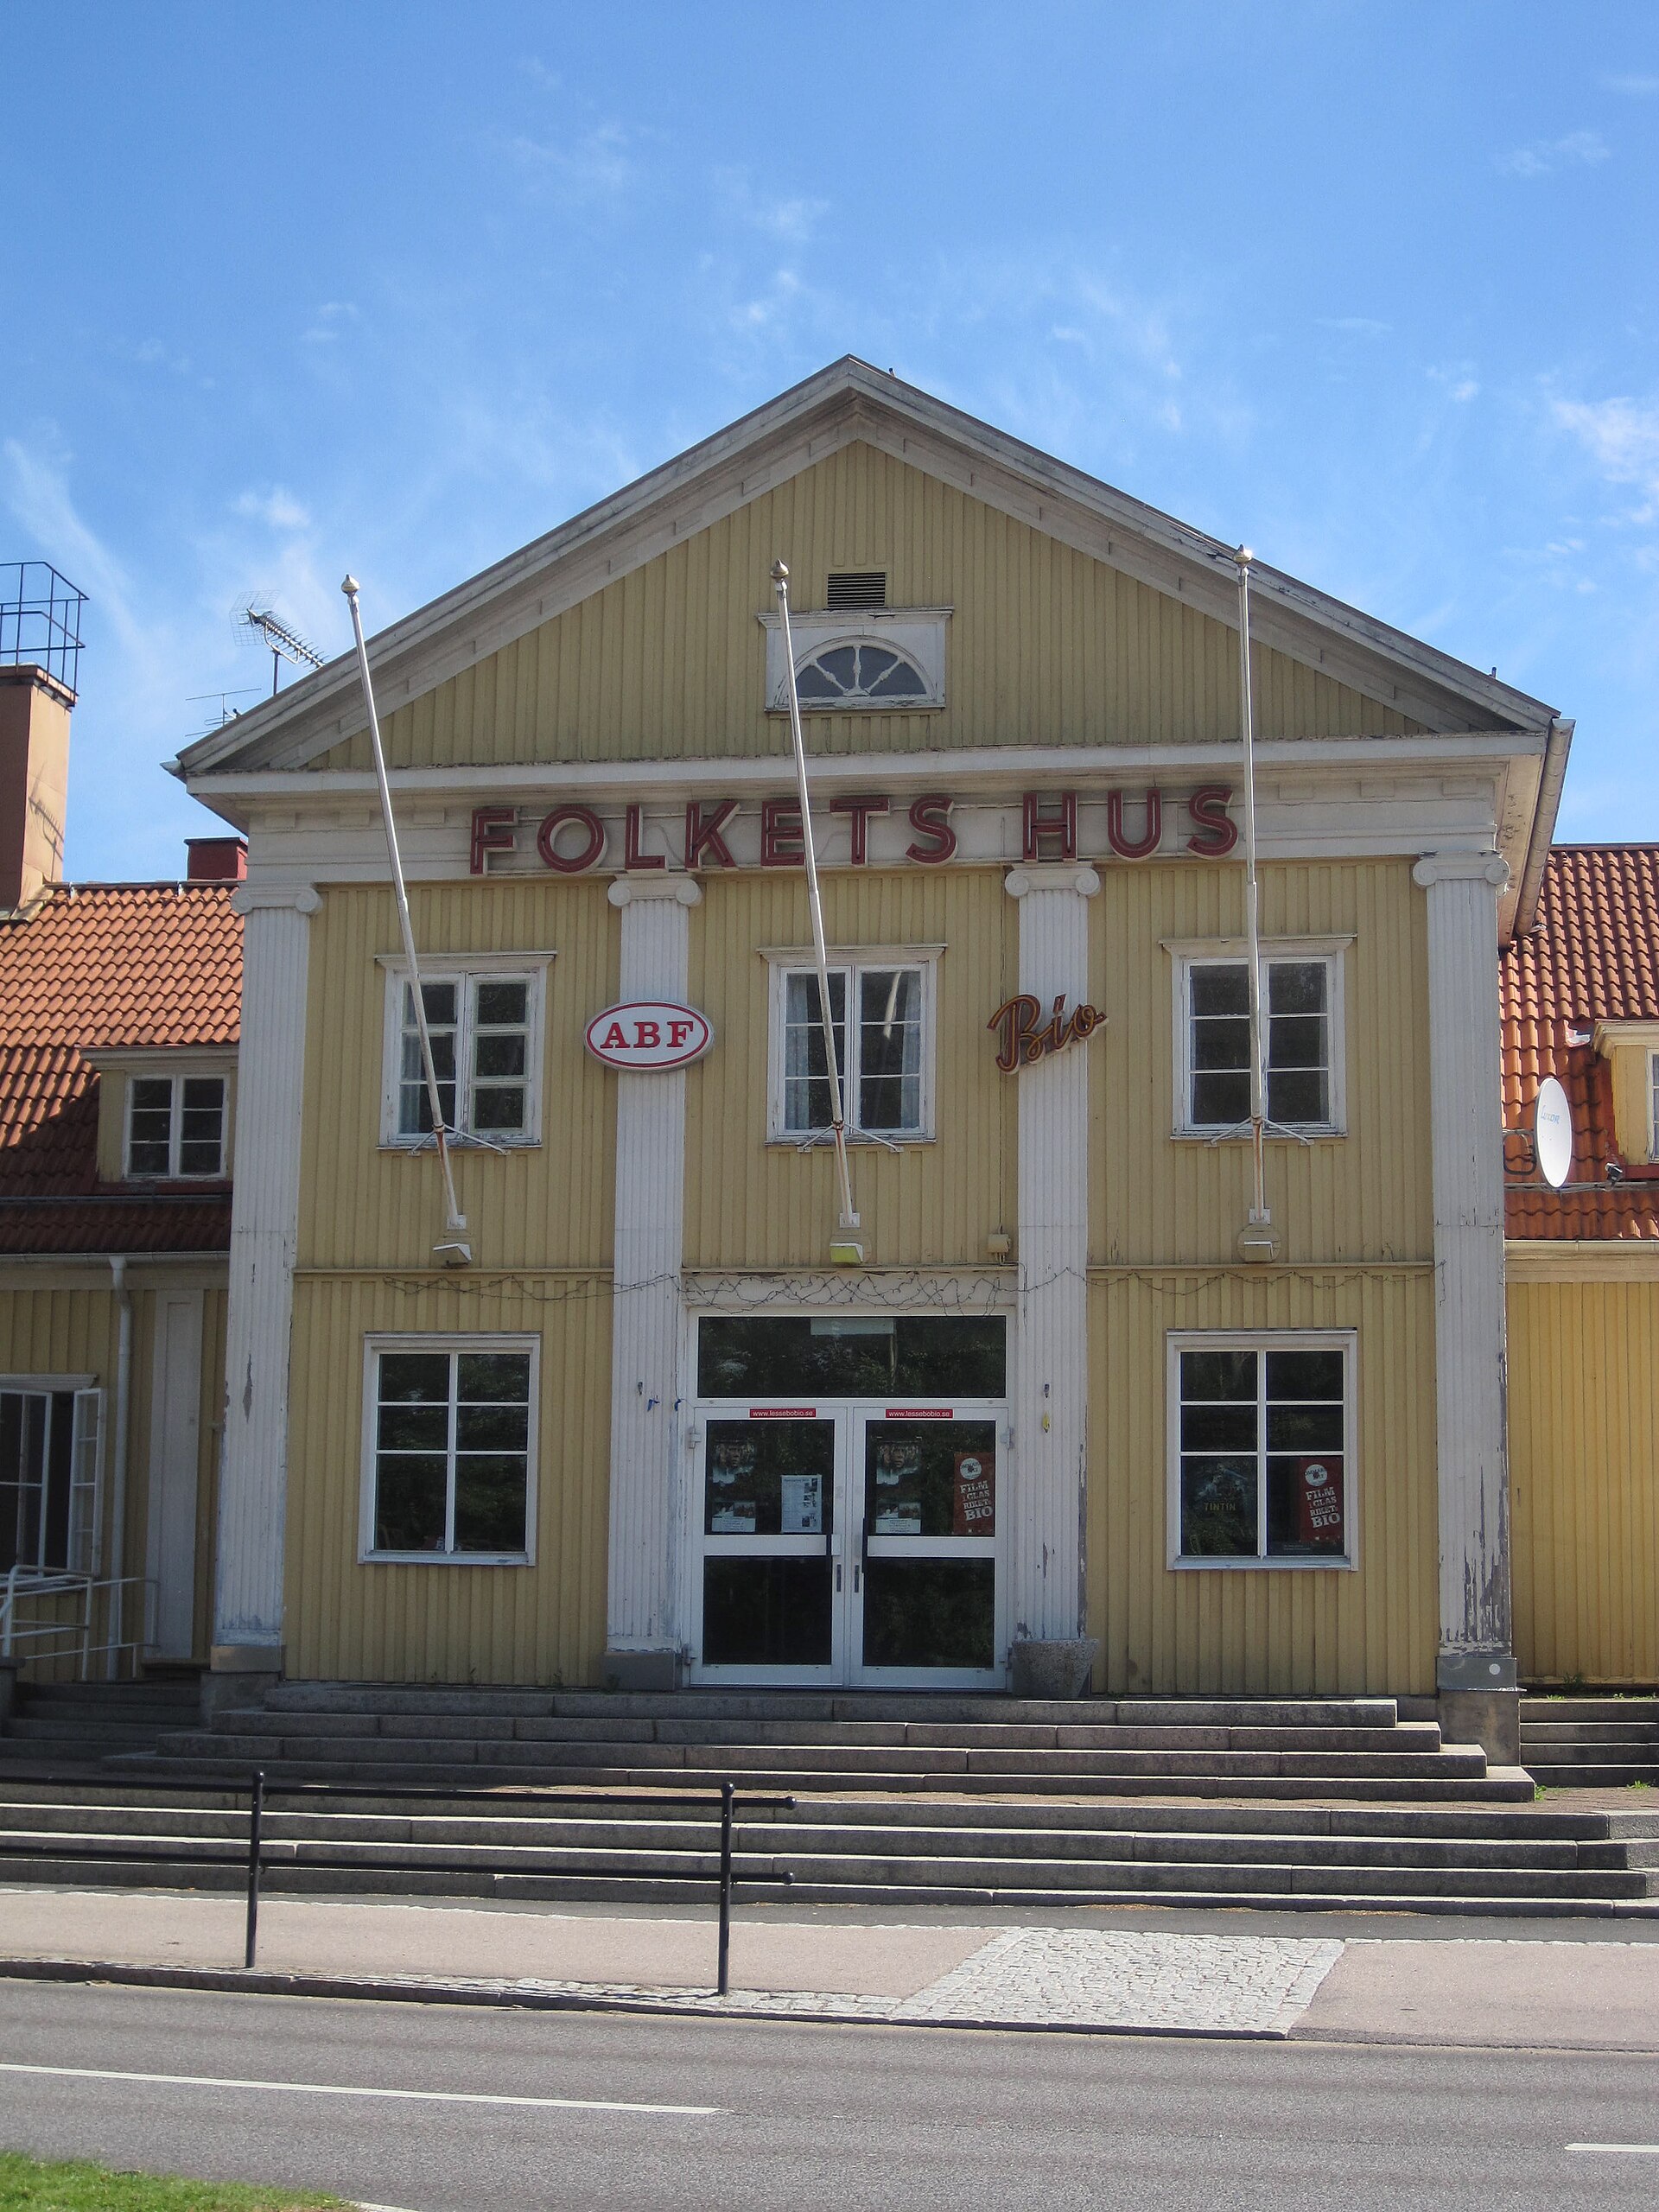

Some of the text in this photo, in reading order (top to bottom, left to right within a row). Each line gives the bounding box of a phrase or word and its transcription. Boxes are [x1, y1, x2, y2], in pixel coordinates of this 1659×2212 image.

[469, 786, 1238, 876] FOLKETS HUS
[600, 1020, 694, 1050] ABF
[987, 993, 1109, 1075] Bio
[960, 1480, 988, 1494] FILM
[1306, 1486, 1335, 1501] FILM
[967, 1490, 989, 1501] GLAS
[1313, 1496, 1337, 1506] GLAS
[964, 1506, 994, 1521] BIO
[1204, 1503, 1236, 1511] TINTIN
[1311, 1513, 1340, 1528] BIO
